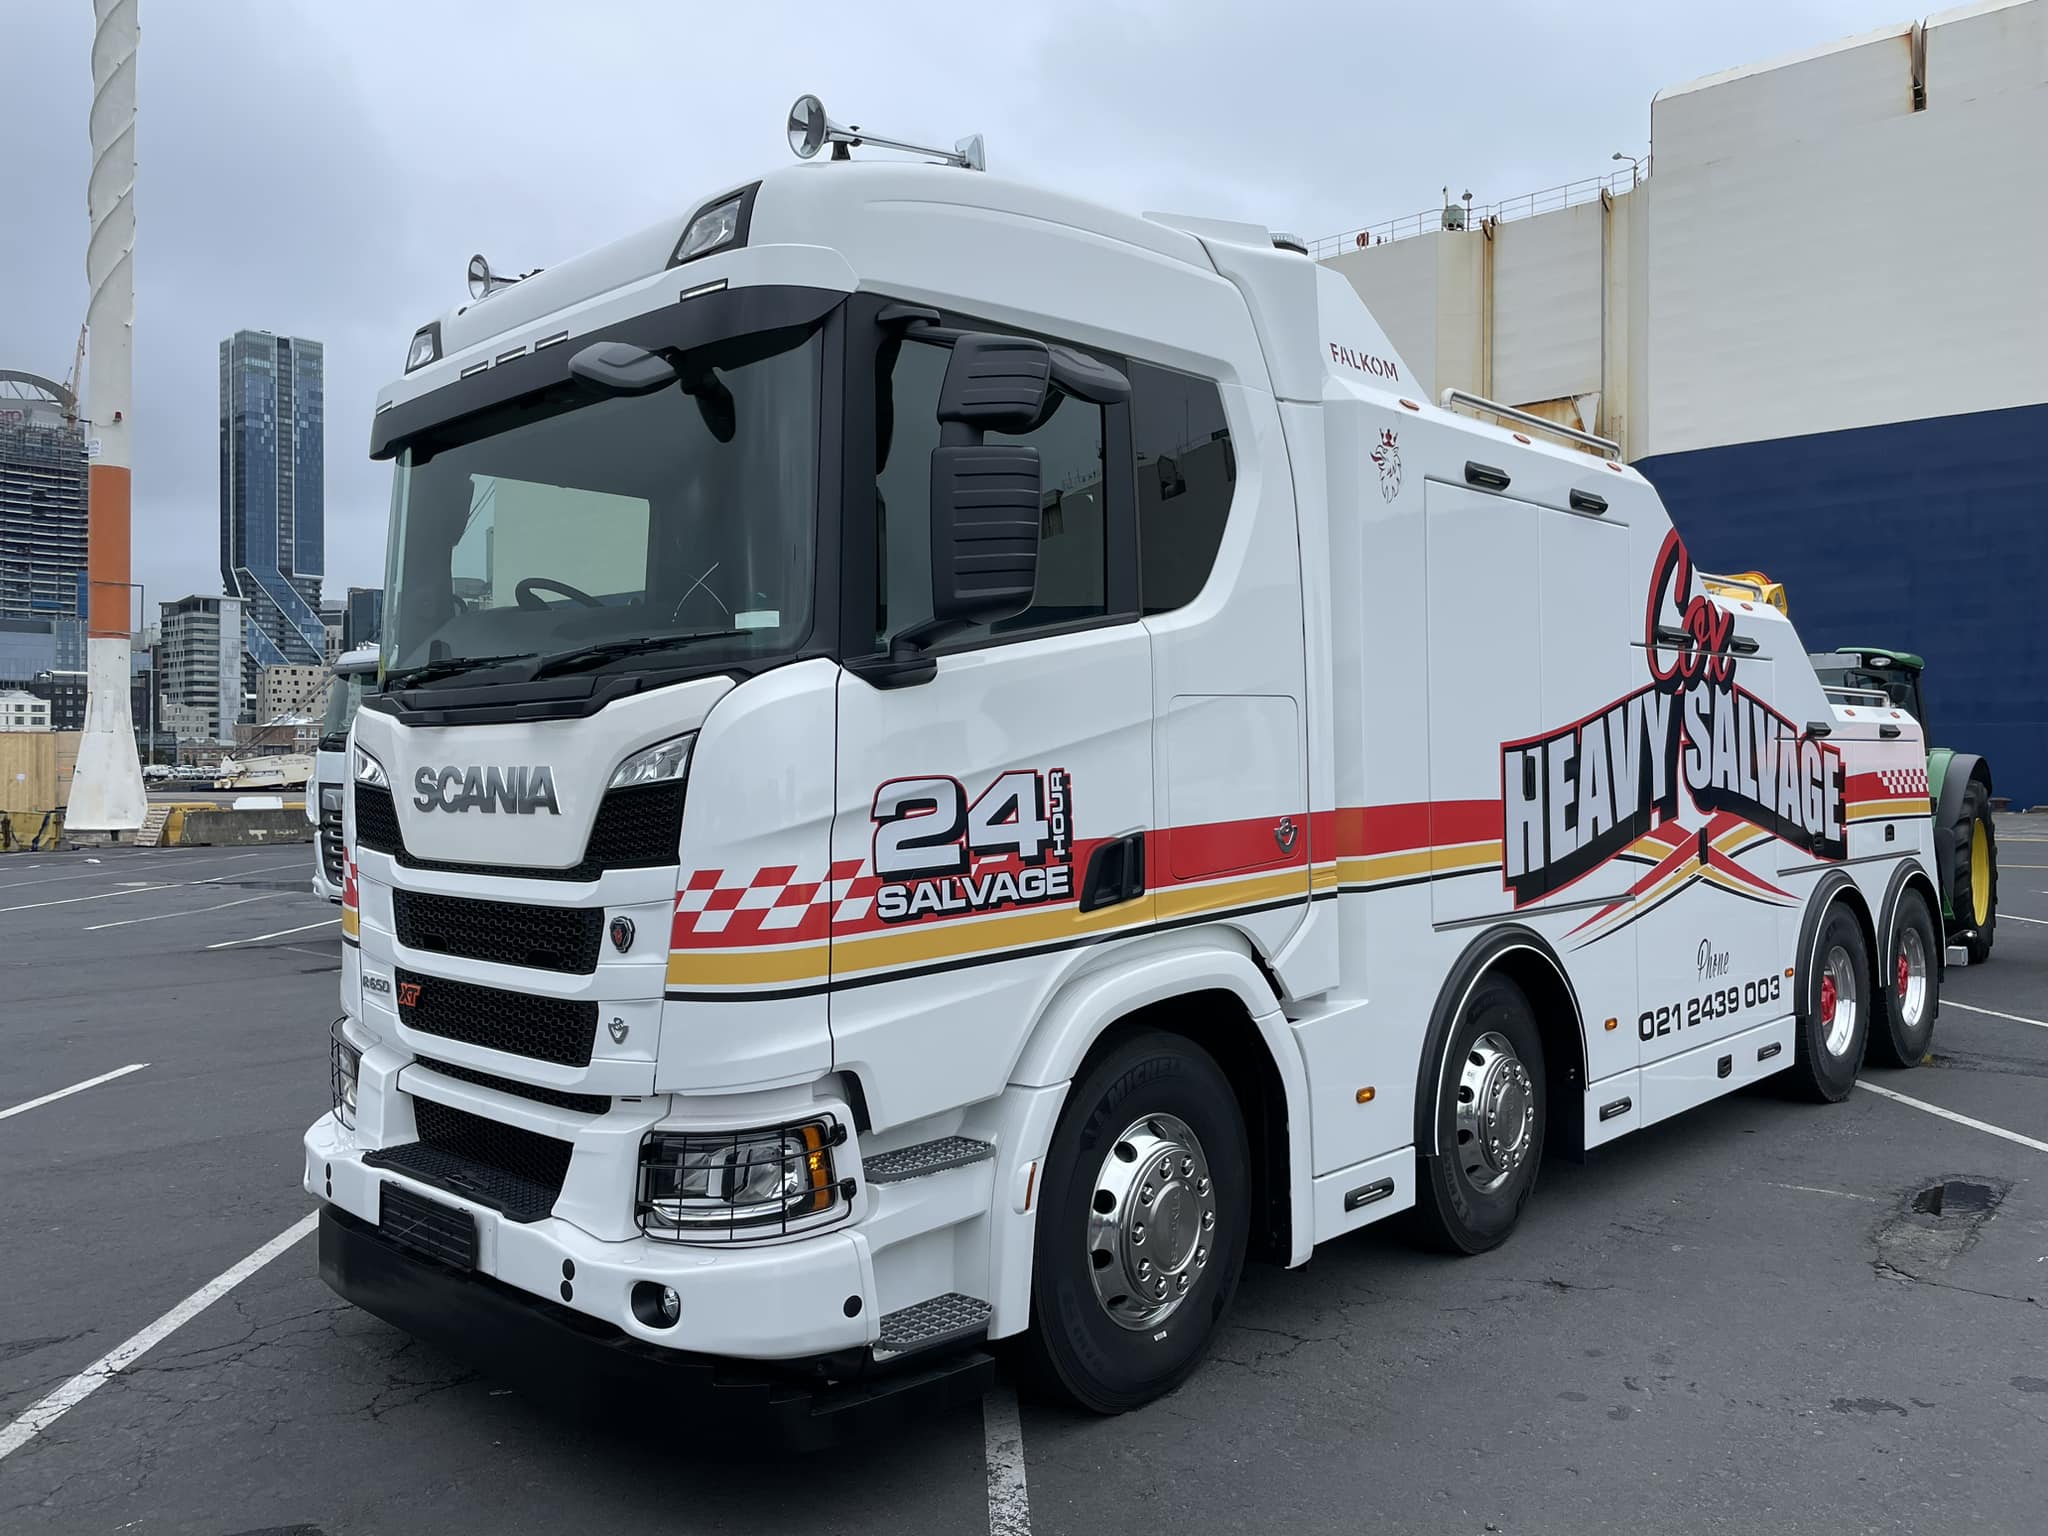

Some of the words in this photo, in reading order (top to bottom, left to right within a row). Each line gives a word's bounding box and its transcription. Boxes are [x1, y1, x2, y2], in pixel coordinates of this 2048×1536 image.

[1328, 342, 1399, 382] FALKOM
[1645, 527, 1736, 692] Cox
[413, 765, 562, 815] SCANIA
[1503, 688, 1673, 879] HEAVY
[1684, 680, 1842, 844] SALVAGE
[871, 769, 1050, 876] 24
[1050, 770, 1067, 857] HOUR
[876, 865, 1071, 920] SALVAGE
[1697, 937, 1730, 983] Phone
[399, 981, 422, 1008] XT
[1638, 1002, 1682, 1041] 021
[1687, 985, 1739, 1027] 2439
[1744, 975, 1780, 1008] 003
